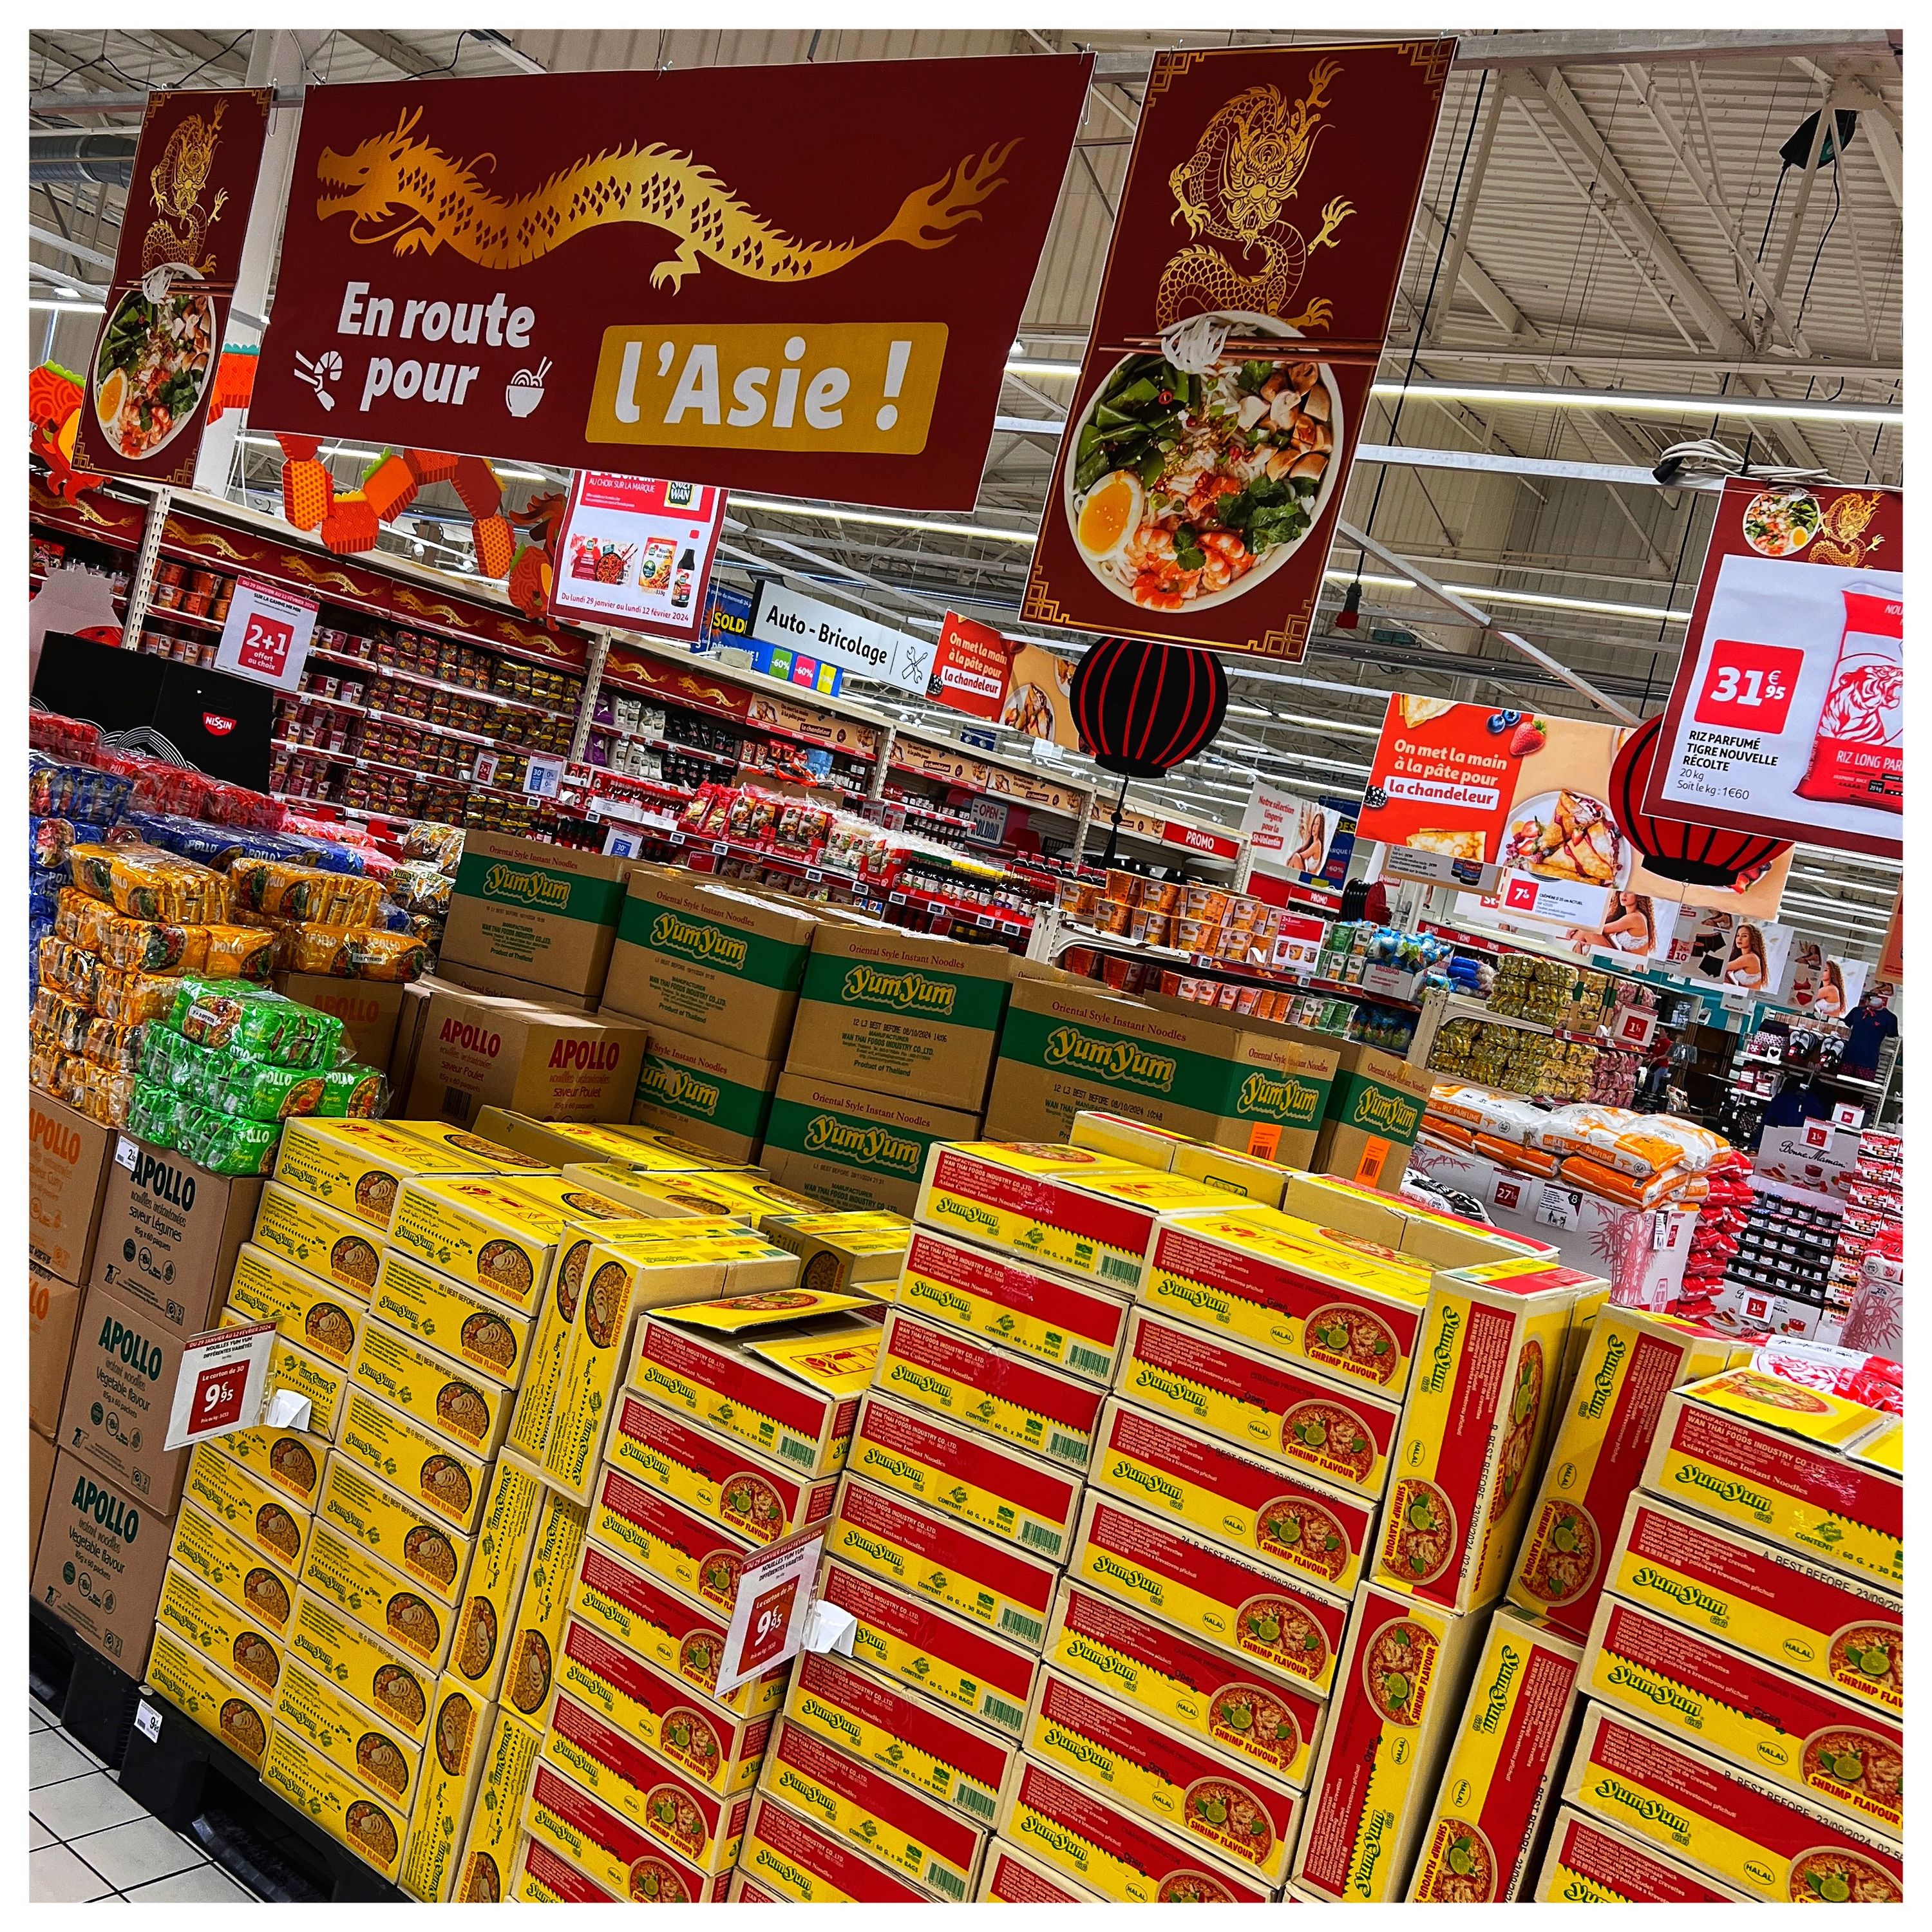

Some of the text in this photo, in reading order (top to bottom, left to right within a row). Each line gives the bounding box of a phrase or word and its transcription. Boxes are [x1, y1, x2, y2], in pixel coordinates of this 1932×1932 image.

[337, 281, 535, 348] En route
[359, 357, 480, 412] pour
[876, 341, 912, 430] !
[597, 478, 613, 489] CHOIX
[614, 480, 624, 489] SUR
[632, 483, 655, 493] MARQUE
[671, 489, 690, 500] WAN
[269, 598, 285, 607] GAMME
[562, 592, 570, 601] Du
[571, 594, 585, 603] lundi
[594, 597, 615, 609] janvier
[625, 601, 641, 612] lundi
[643, 606, 649, 614] 12
[651, 606, 671, 619] février
[672, 611, 688, 621] 2024
[246, 624, 287, 656] 2+1
[766, 605, 887, 665] Auto Bricolage
[254, 651, 274, 662] offert
[950, 632, 1007, 665] On met la main
[258, 658, 276, 670] choix
[772, 659, 789, 670] -60%
[795, 667, 813, 678] -60%
[949, 647, 1002, 678] à la pâte pour
[945, 669, 998, 694] la chandeleur
[1710, 666, 1763, 707] 31
[1765, 685, 1786, 701] 95
[205, 715, 233, 730] NISSIN
[1689, 730, 1761, 750] RIZ PARFUMÉ
[1394, 739, 1508, 770] On met la main
[1683, 755, 1730, 772] RÉCOLTE
[1687, 743, 1778, 766] TIGRE NOUVELLE
[1836, 750, 1880, 769] RIZ LONG
[1394, 755, 1499, 786] à la pâte pour
[1680, 768, 1704, 782] 20 kg
[1389, 779, 1494, 804] la chandeleur
[1677, 780, 1694, 790] Soit
[1696, 782, 1704, 792] le
[1723, 787, 1749, 800] 1€60
[979, 804, 999, 820] OPEN
[1258, 795, 1294, 814] Notre sélection
[1264, 809, 1283, 823] lingerie
[1261, 822, 1279, 833] pour la
[1185, 831, 1215, 850] PROMO
[1252, 835, 1280, 847] St-Valentin
[1311, 893, 1328, 905] PROMO
[849, 943, 965, 969] Oriental Style Instant Noodles
[439, 1018, 500, 1058] APOLLO
[869, 1030, 909, 1042] MANUFACTURER
[547, 1039, 620, 1072] APOLLO
[553, 1086, 601, 1098] saveur Poulet
[1454, 1108, 1480, 1122] PARFUMÉ
[1779, 1140, 1846, 1168] Bonne Maman
[130, 1151, 196, 1211] APOLLO
[1497, 1188, 1511, 1199] 27
[129, 1206, 182, 1242] saveur Légumes
[478, 1274, 524, 1304] CHICKEN FLAVOUR
[204, 1335, 225, 1344] JANVIER
[239, 1327, 258, 1336] FÉVRIER
[205, 1341, 229, 1351] NOUILLES
[1271, 1329, 1293, 1341] HALAL
[98, 1316, 162, 1381] APOLLO
[203, 1343, 252, 1359] DIFFÉRENTES VARIÉTÉS
[210, 1370, 229, 1379] carton
[1310, 1349, 1378, 1381] SHRIMP FLAVOUR
[97, 1366, 151, 1412] Vegetable flavour
[204, 1384, 220, 1412] 9
[220, 1389, 234, 1403] 95
[1688, 1409, 1749, 1436] MANUFACTURER
[1687, 1416, 1793, 1461] WAN THAI FOODS INDUSTRY
[1679, 1441, 1705, 1457] Asian
[1705, 1449, 1738, 1468] Cuisine
[1739, 1462, 1771, 1481] Instant
[1772, 1475, 1808, 1495] Noodles
[71, 1475, 139, 1544] APOLLO
[1794, 1531, 1833, 1553] CONTENT
[1775, 1555, 1850, 1592] BEST BEFORE
[755, 1610, 782, 1647] 9 95
[1811, 1777, 1900, 1824] SHRIMP FLAVOUR
[1815, 1813, 1871, 1846] 23/09/2024
